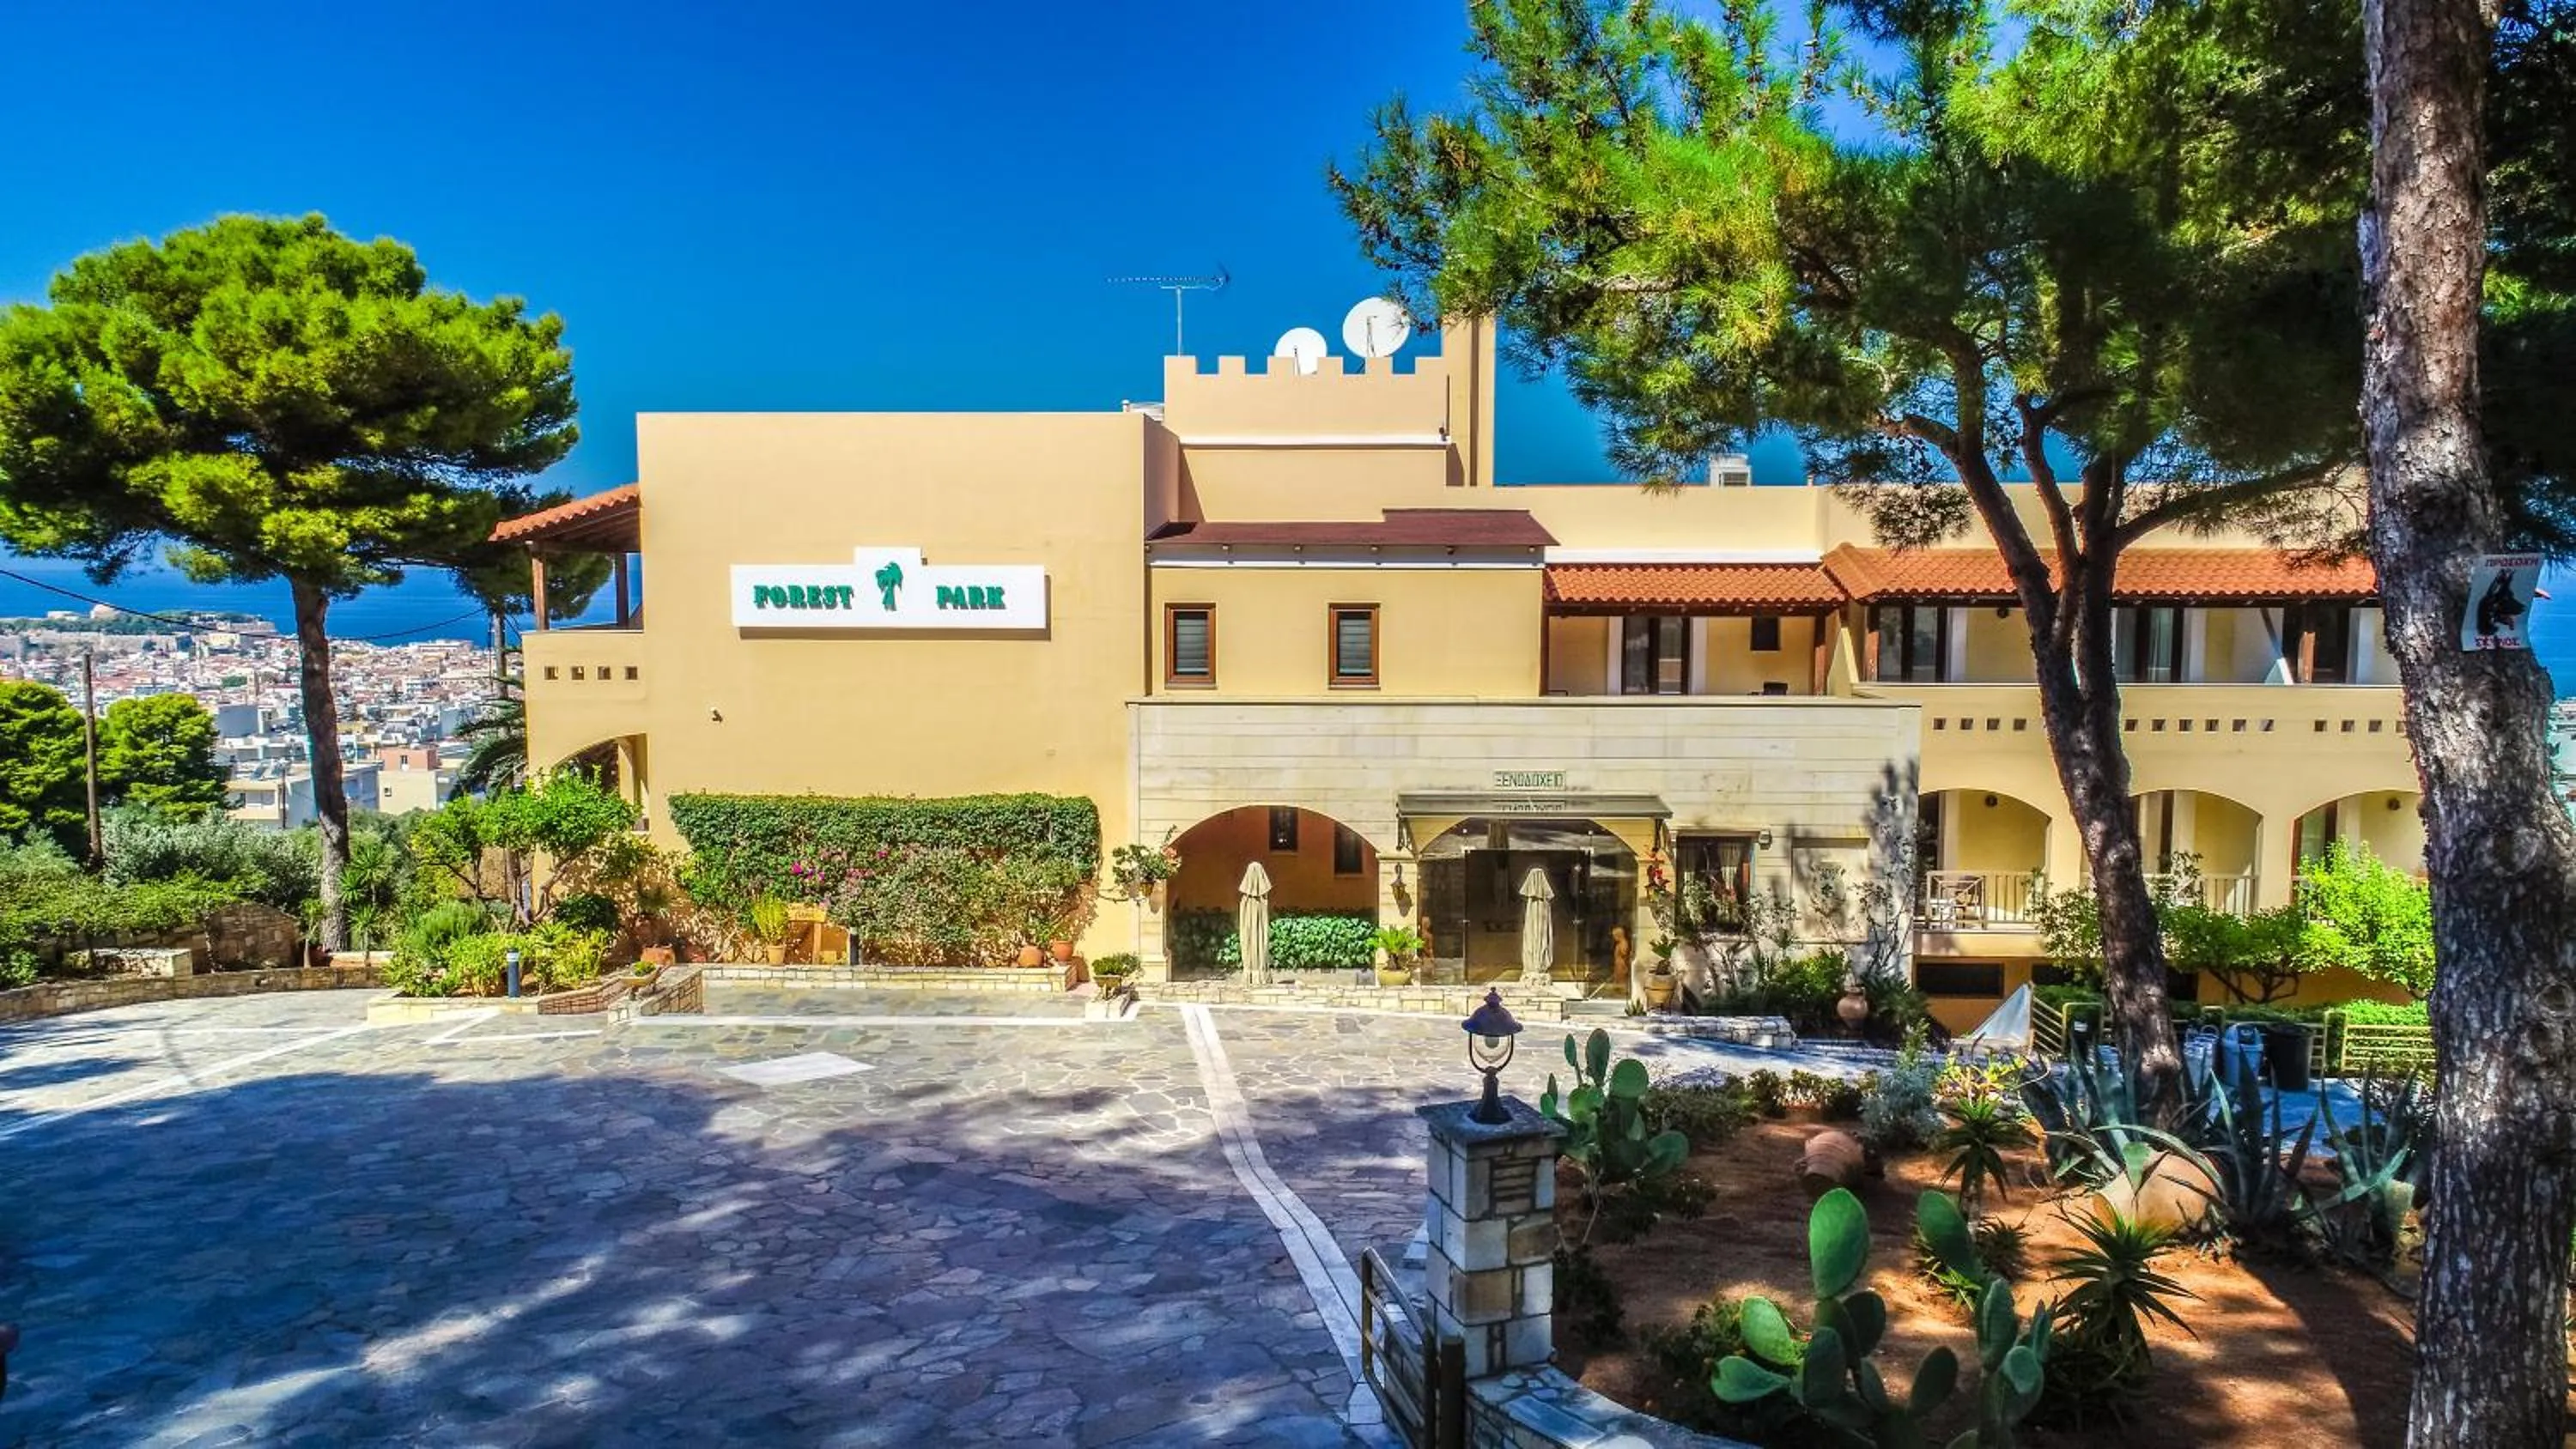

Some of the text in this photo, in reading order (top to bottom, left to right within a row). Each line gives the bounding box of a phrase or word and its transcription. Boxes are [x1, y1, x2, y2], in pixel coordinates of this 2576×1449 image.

[753, 585, 1006, 609] FOREST PARK
[1494, 772, 1564, 787] ΞΕΝΟΔΟΧΕΙΟ
